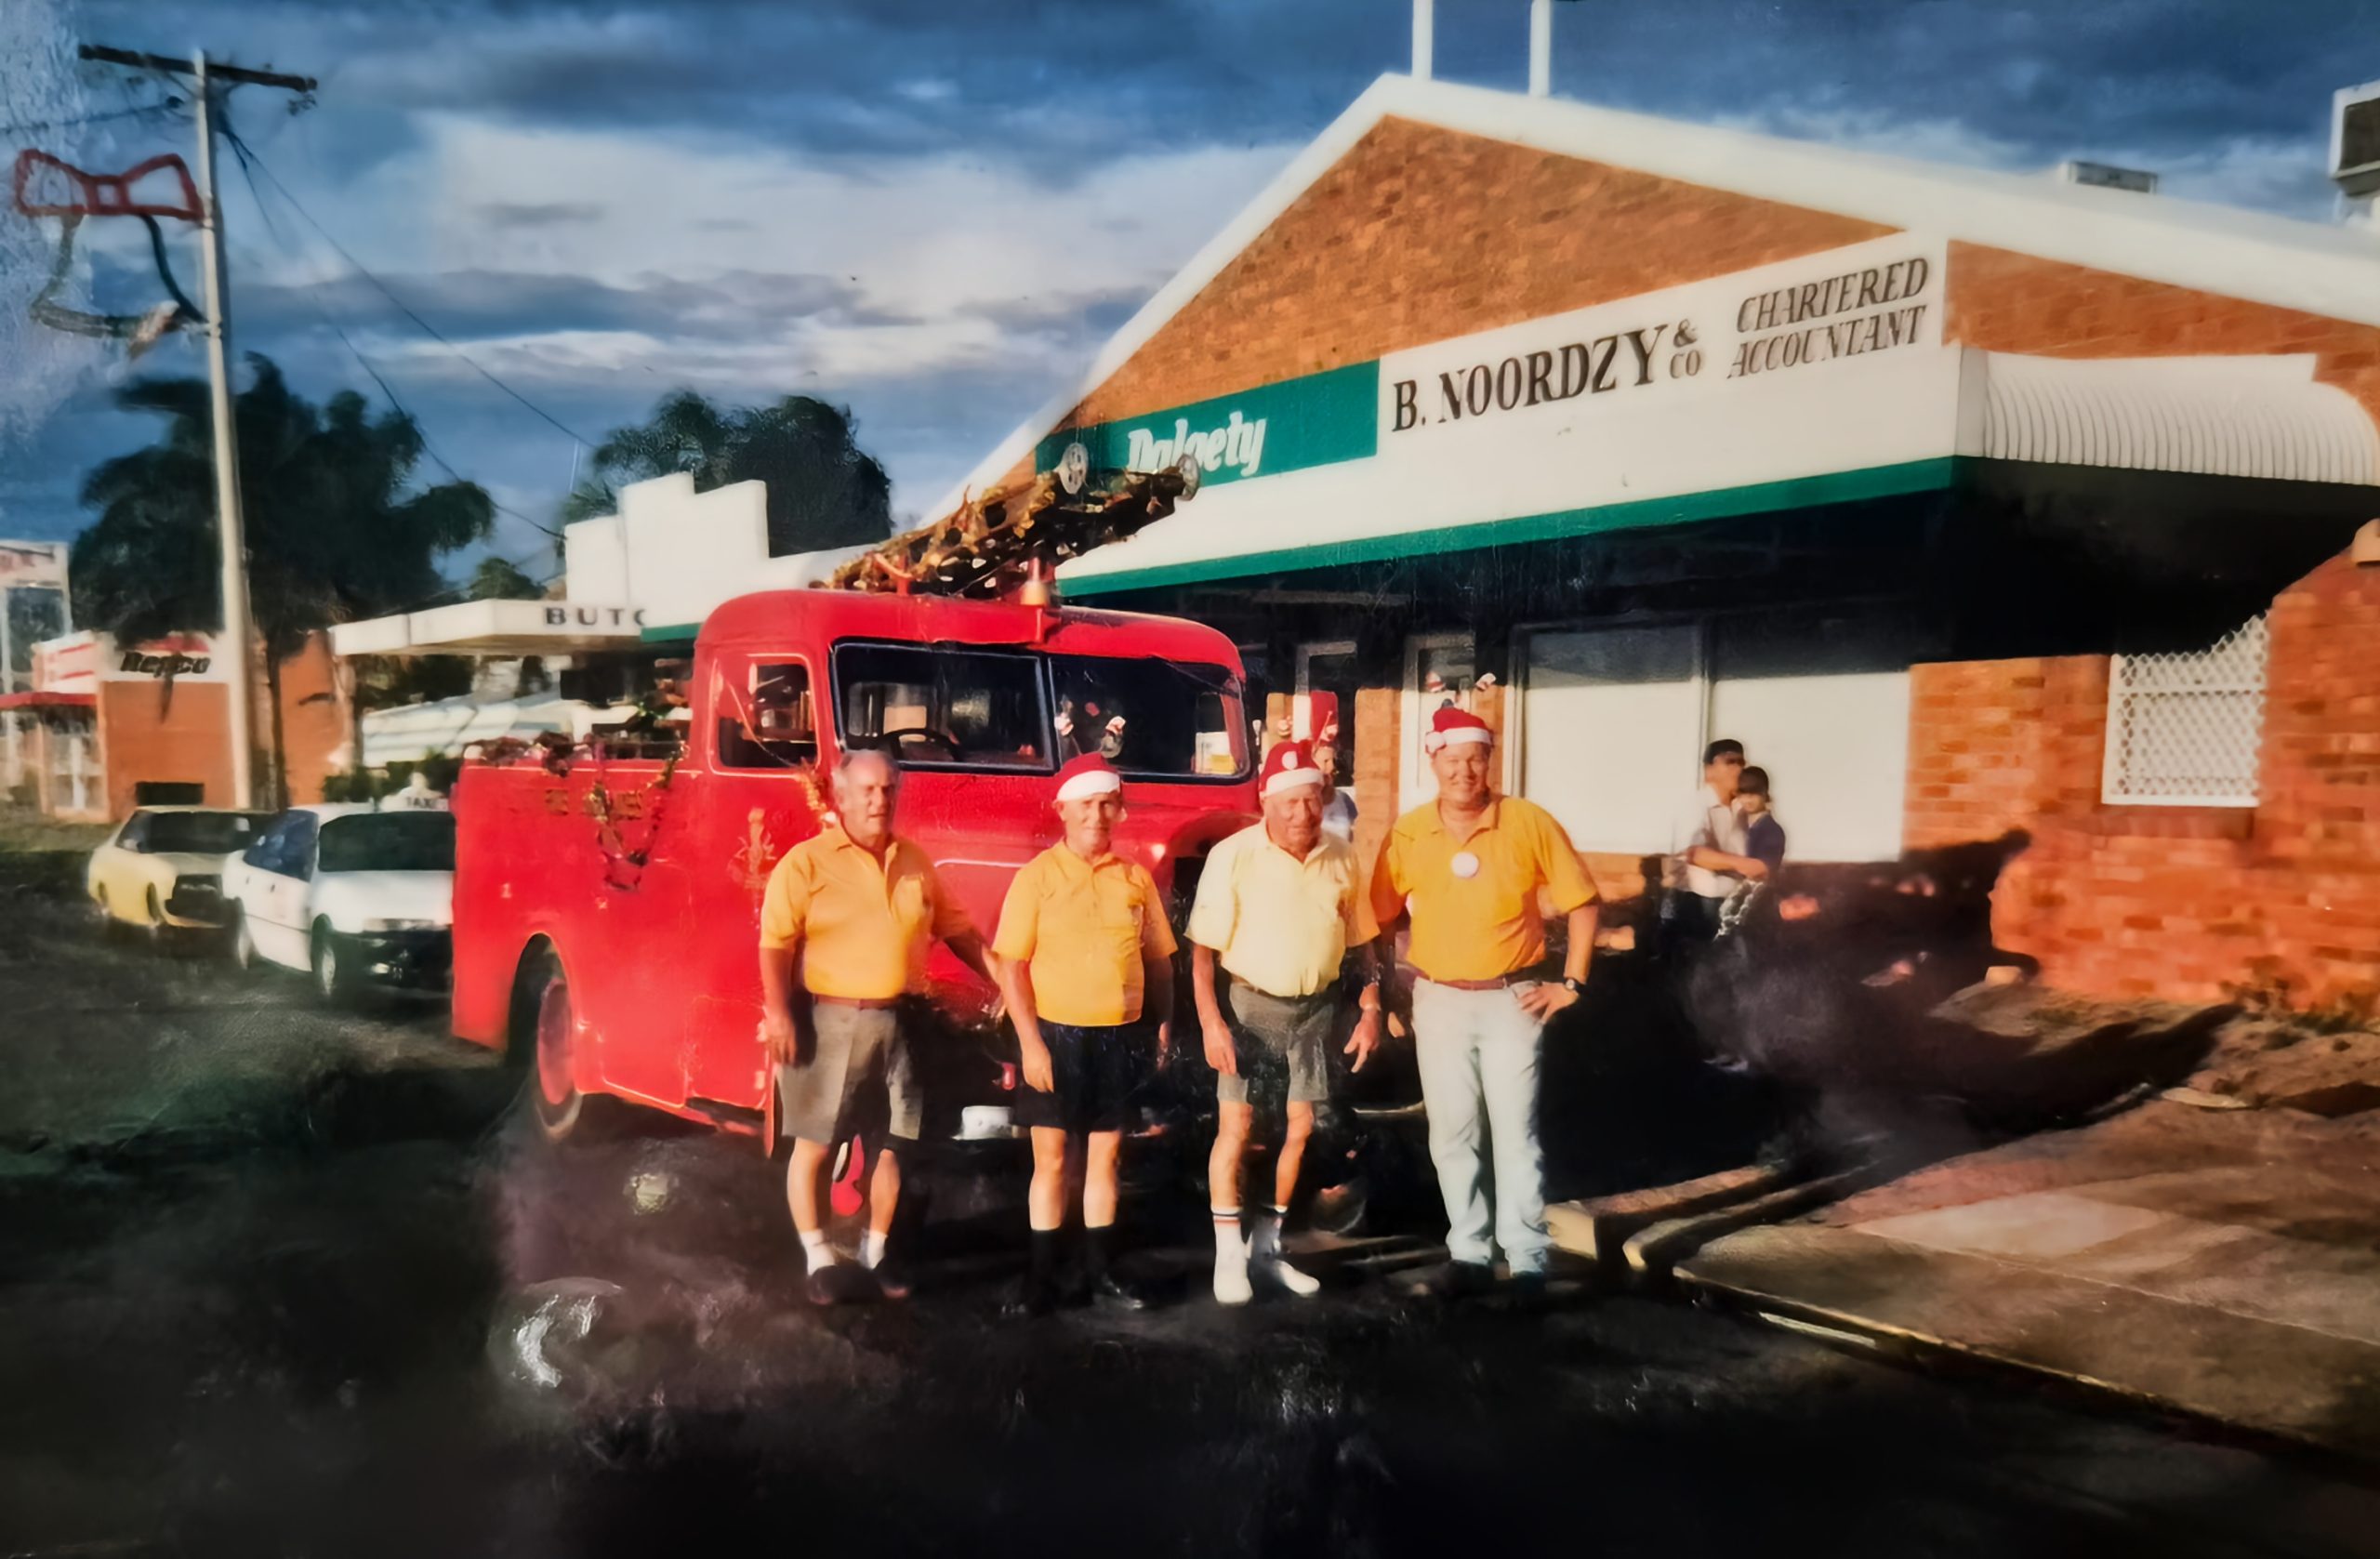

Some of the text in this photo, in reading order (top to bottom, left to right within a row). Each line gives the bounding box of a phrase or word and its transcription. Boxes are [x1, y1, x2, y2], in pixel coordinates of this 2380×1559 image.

[1736, 258, 1929, 334] CHARTERED
[1392, 319, 1698, 432] B. NOORDZY &
[1726, 305, 1927, 379] ACCOUNTANT
